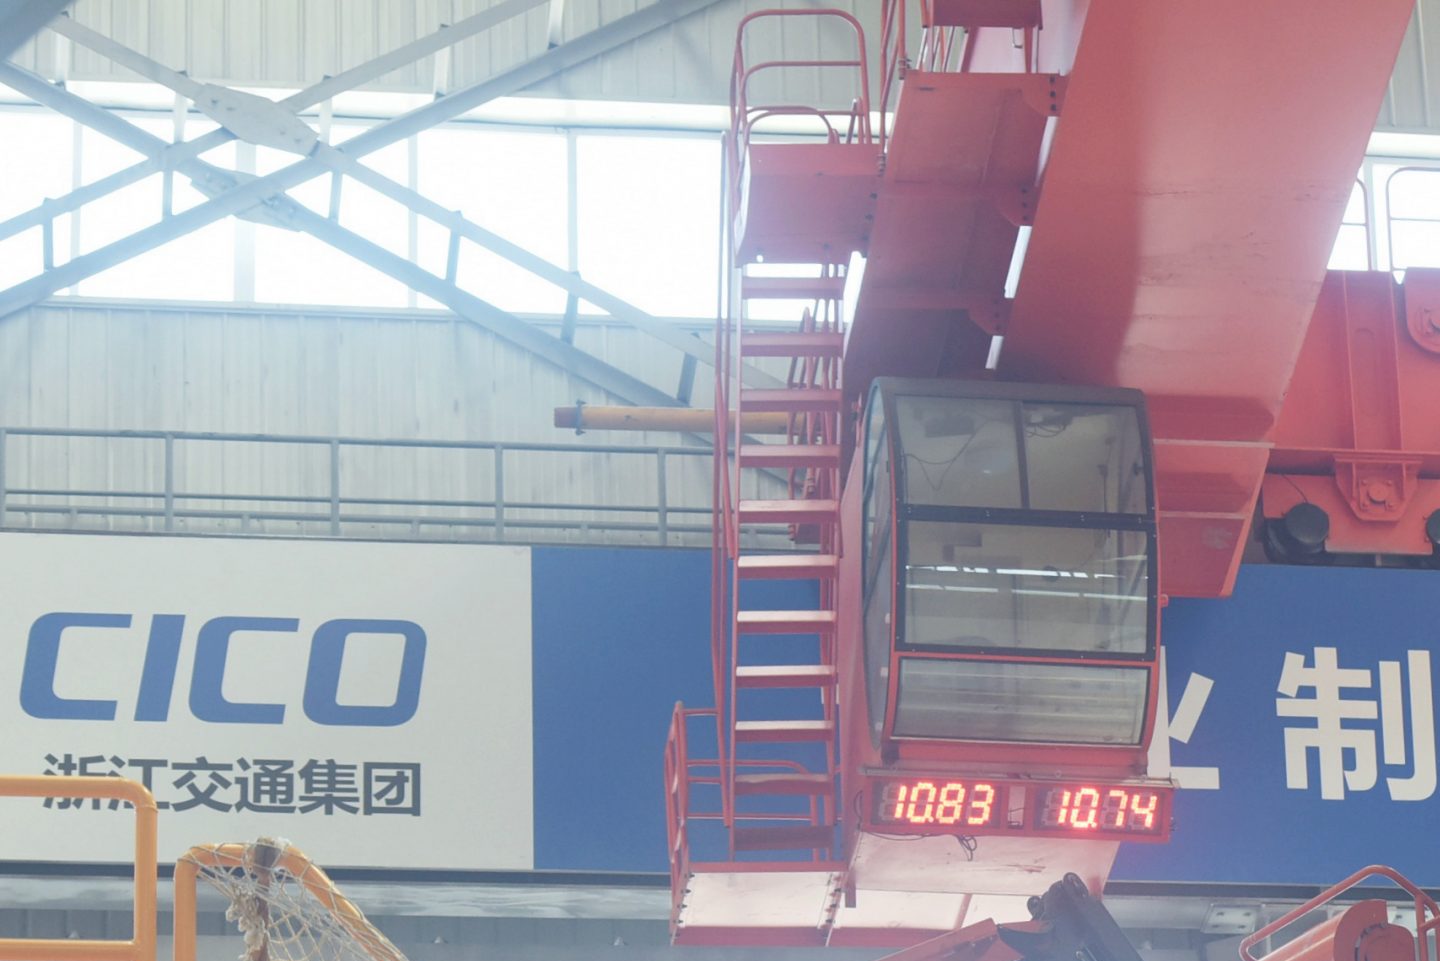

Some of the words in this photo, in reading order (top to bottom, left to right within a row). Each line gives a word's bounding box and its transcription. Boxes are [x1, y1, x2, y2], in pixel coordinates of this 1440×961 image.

[19, 611, 428, 727] CICO
[42, 753, 422, 817] 浙江交通集团
[894, 781, 995, 826] 10.83
[1056, 787, 1158, 829] 10.74
